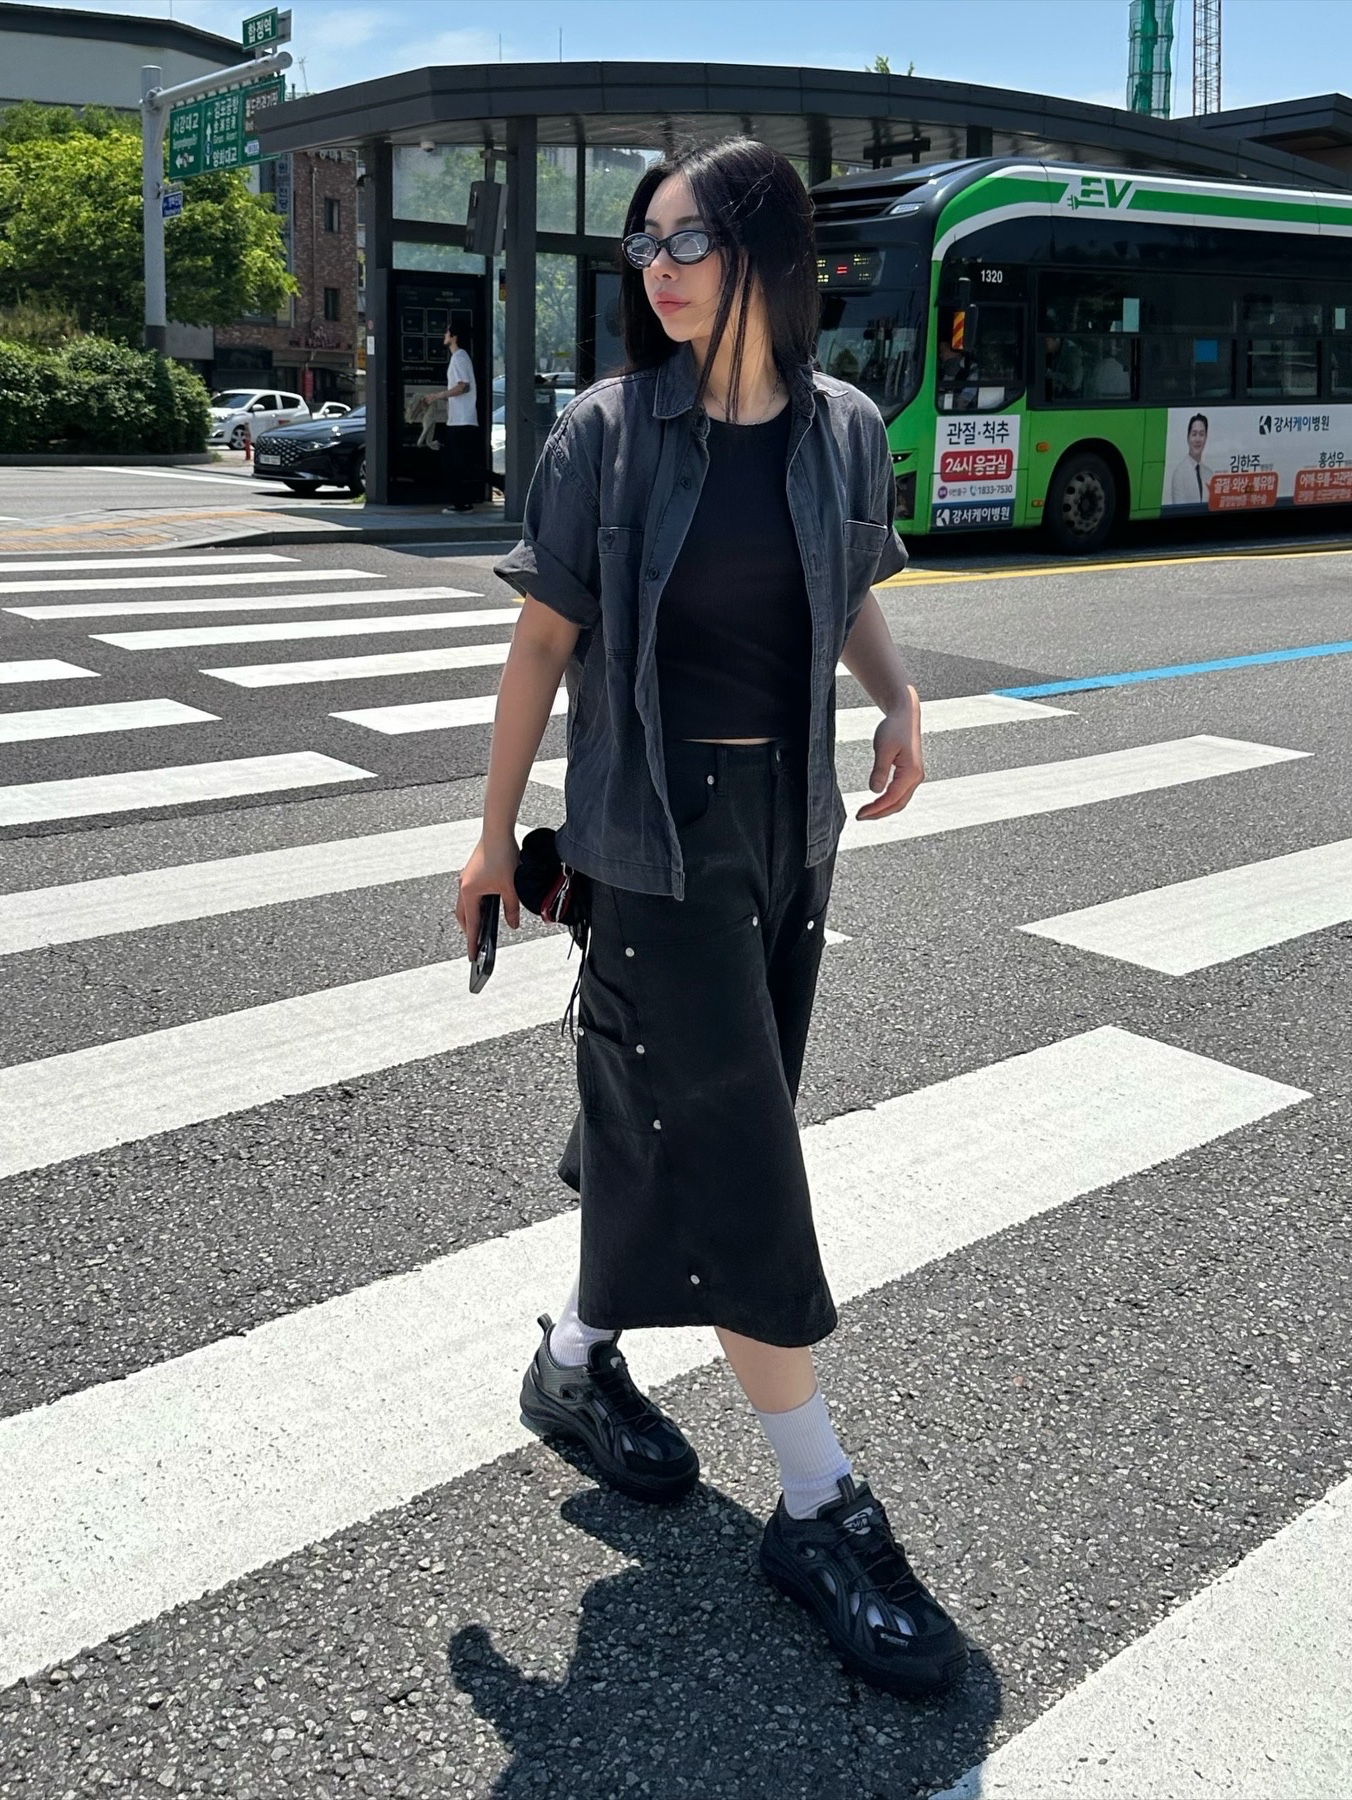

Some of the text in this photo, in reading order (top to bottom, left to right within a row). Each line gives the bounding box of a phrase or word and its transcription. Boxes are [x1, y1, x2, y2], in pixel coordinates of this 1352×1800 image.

[248, 15, 272, 43] 합정역
[214, 95, 239, 119] 김포공항
[173, 112, 199, 134] 서강대교
[1079, 176, 1133, 209] EV
[980, 269, 1003, 284] 1320
[1274, 415, 1330, 433] 강서케이병원
[973, 454, 1008, 476] 응급실
[1230, 454, 1261, 473] 김한주
[1318, 451, 1345, 468] 홍성우
[978, 484, 1013, 495] 1833-7530
[952, 506, 1010, 524] 강서케이병원
